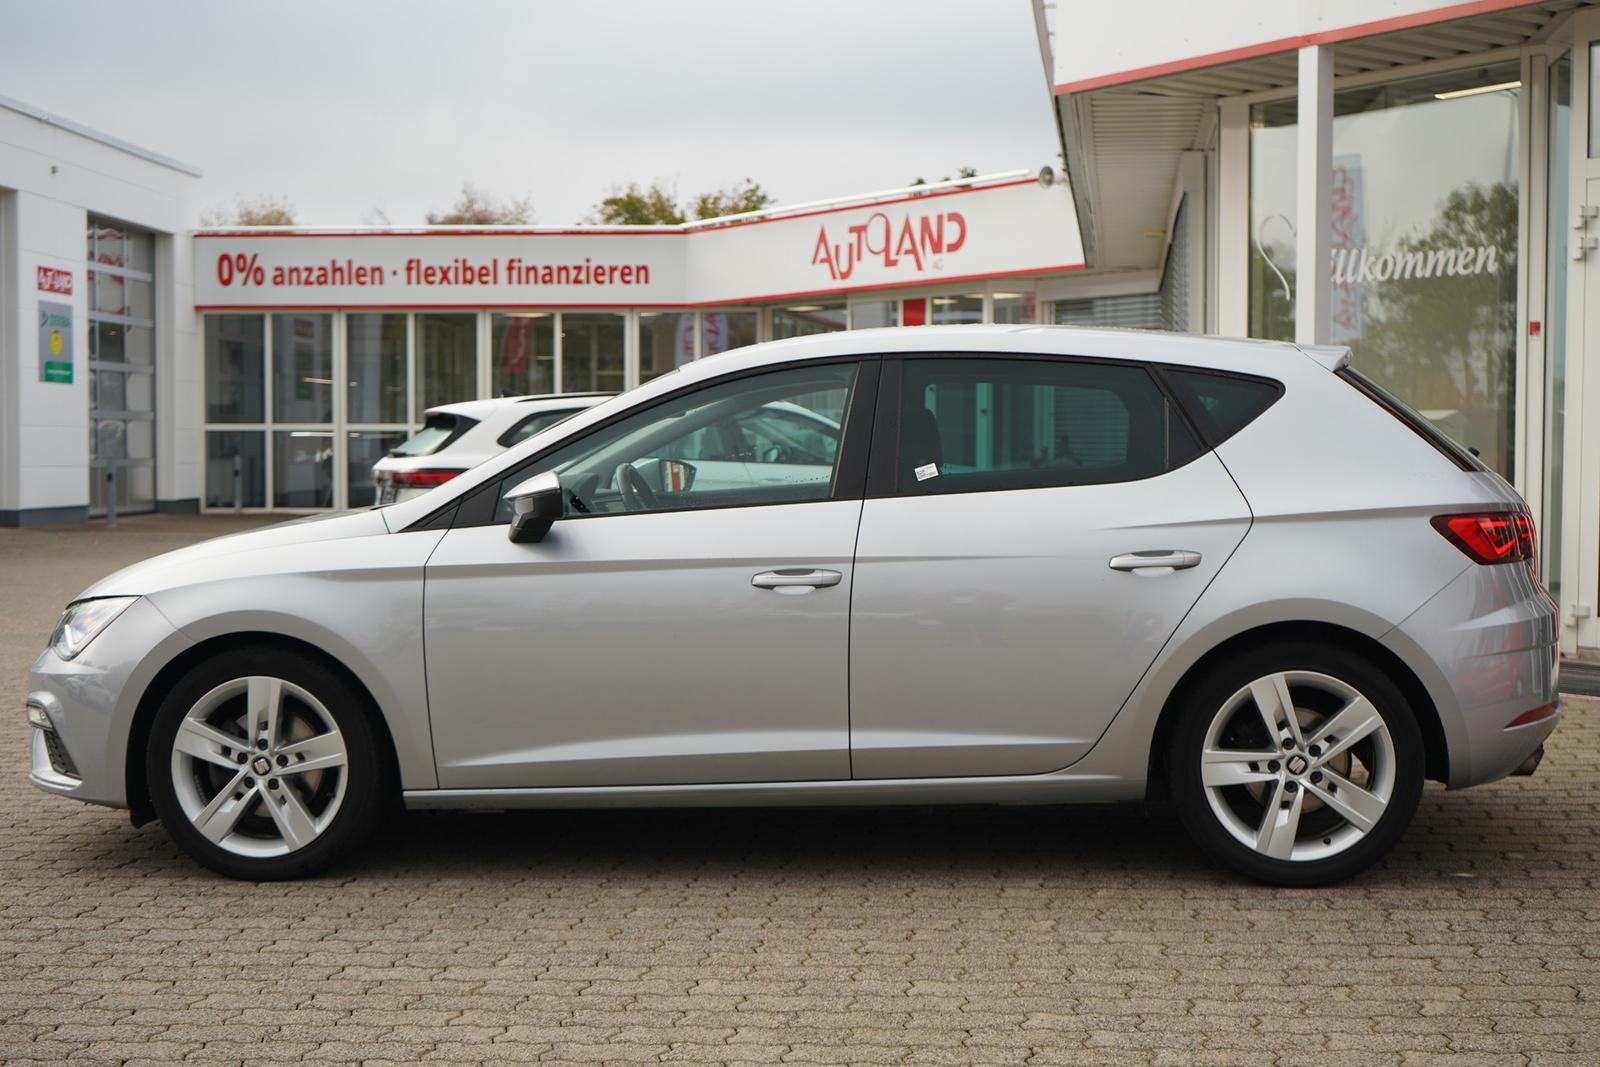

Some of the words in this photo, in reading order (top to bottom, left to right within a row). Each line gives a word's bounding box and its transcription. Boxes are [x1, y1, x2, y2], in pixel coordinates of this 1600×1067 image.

[216, 252, 265, 288] 0%
[271, 260, 384, 287] anzahlen
[404, 258, 499, 286] flexibel
[505, 257, 650, 286] finanzieren
[811, 211, 968, 280] AUTOLAND
